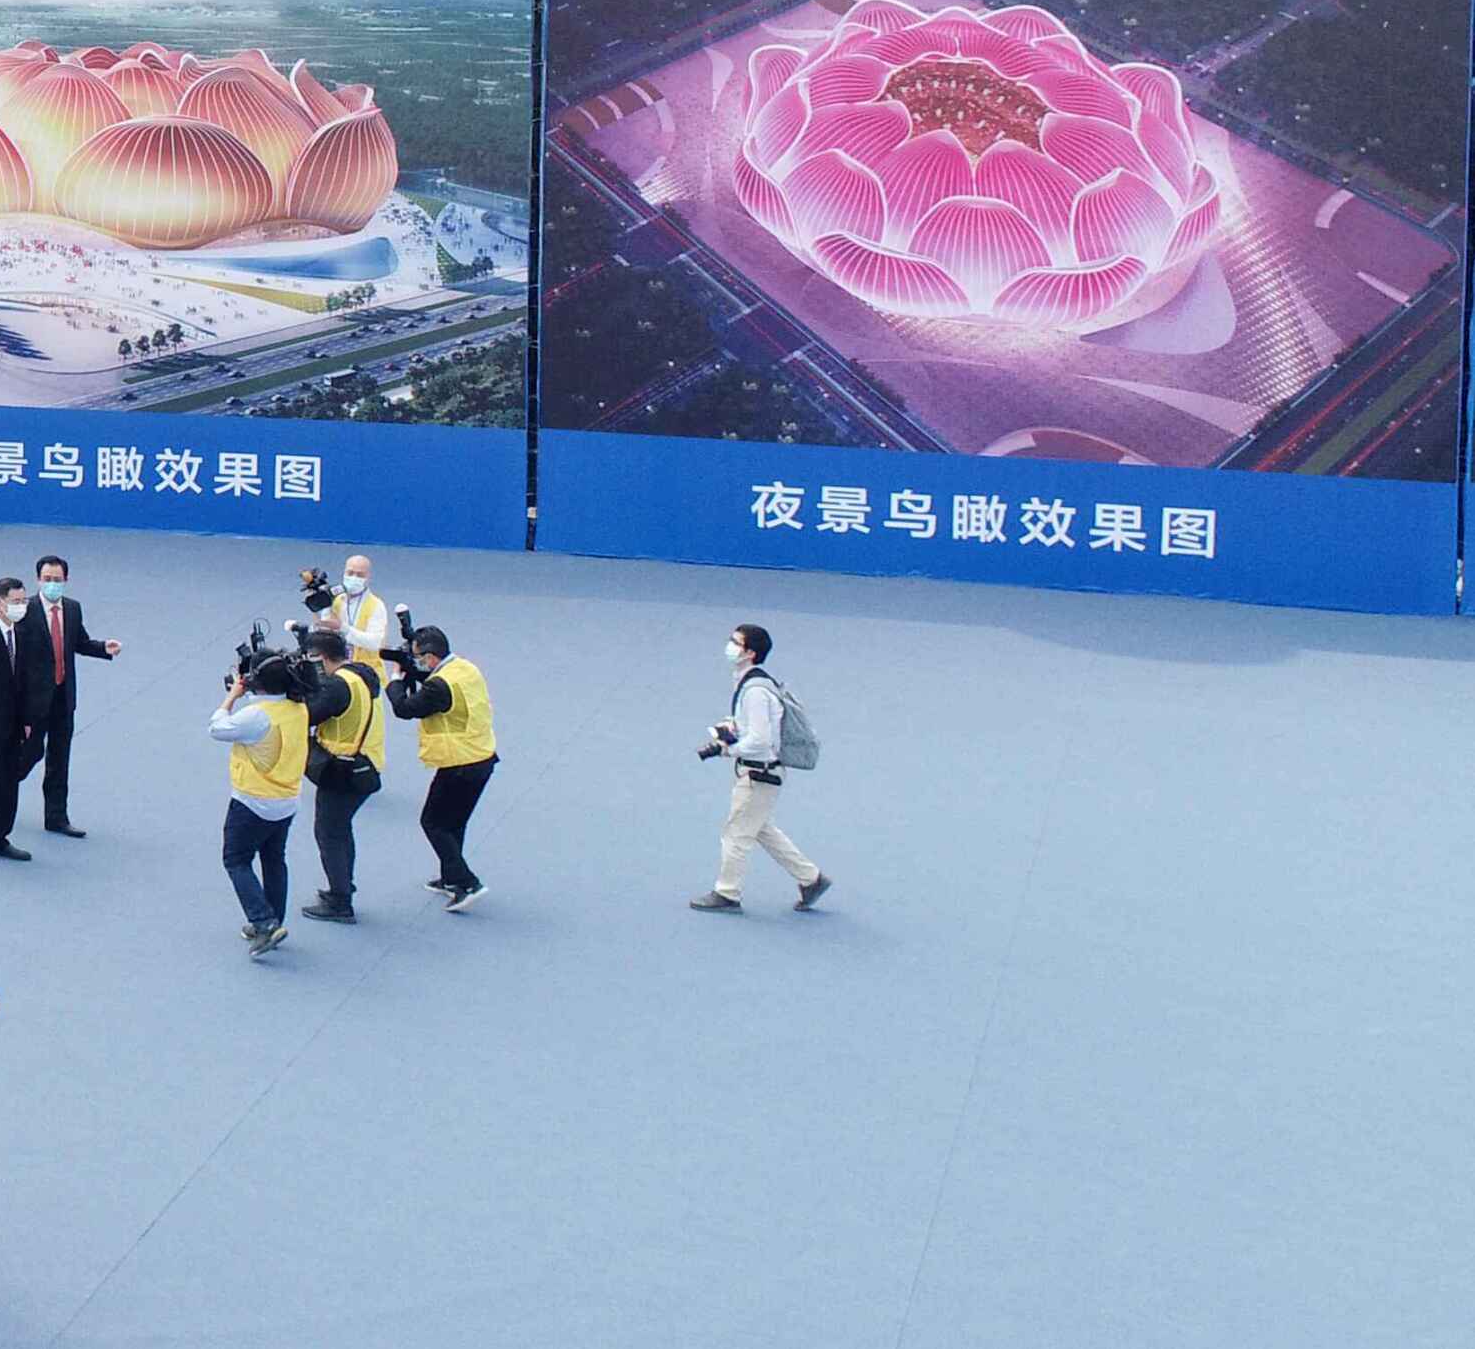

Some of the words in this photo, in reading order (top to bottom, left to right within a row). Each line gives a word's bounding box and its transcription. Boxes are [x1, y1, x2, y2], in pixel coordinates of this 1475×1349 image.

[750, 480, 1218, 559] 夜景鸟瞰效果图
